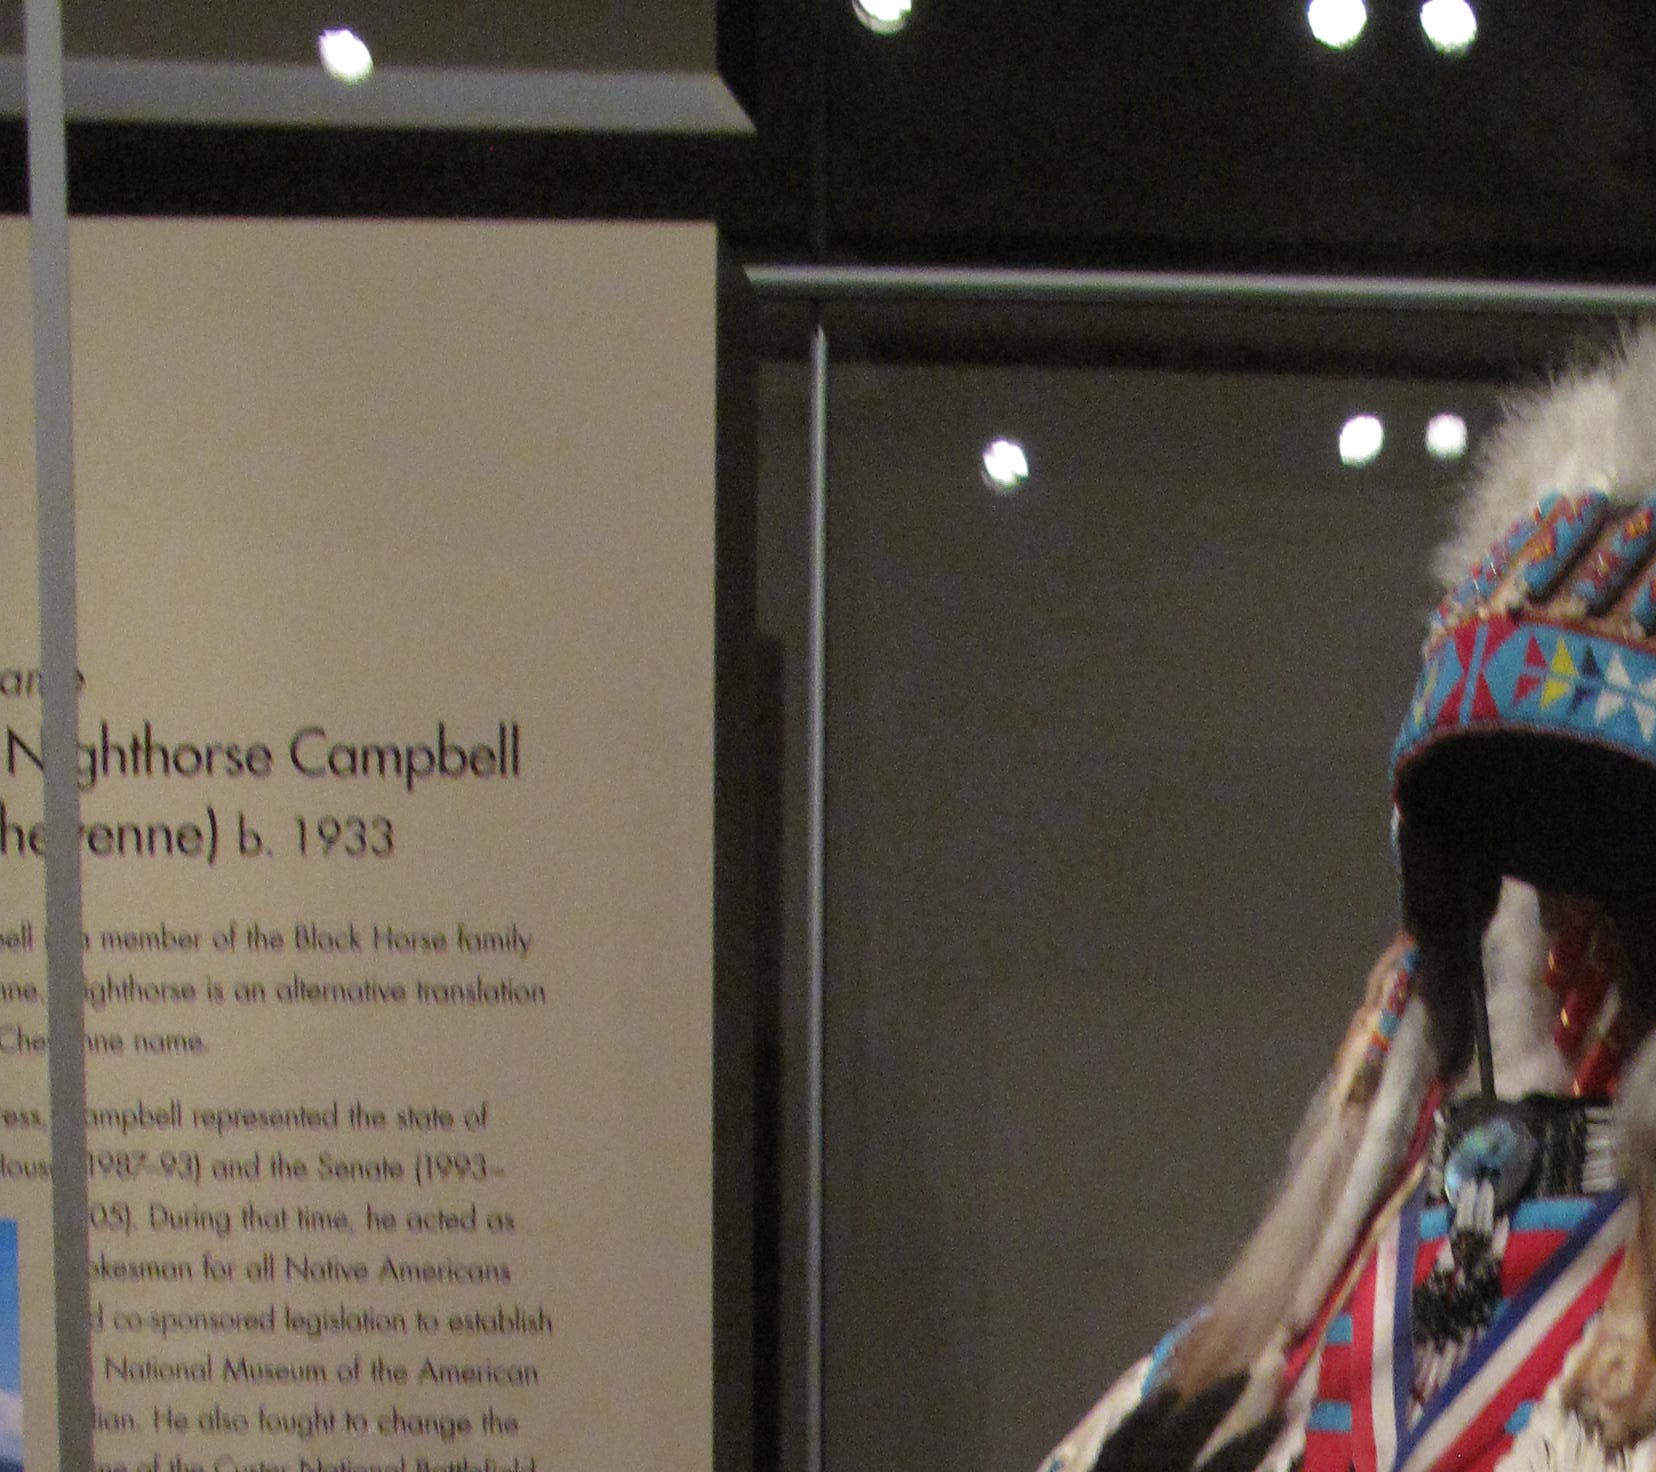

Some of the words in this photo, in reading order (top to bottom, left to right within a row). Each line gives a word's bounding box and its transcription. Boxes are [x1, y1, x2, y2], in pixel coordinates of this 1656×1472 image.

[7, 717, 273, 792] Nghthorse
[289, 719, 519, 795] Campbell
[238, 808, 273, 858] b.
[298, 812, 394, 858] 1933
[102, 922, 199, 952] member
[212, 919, 236, 953] of
[246, 922, 285, 952] the
[294, 920, 360, 951] Black
[372, 921, 447, 951] Horse
[457, 921, 533, 960] family
[206, 974, 225, 1003] is
[234, 982, 266, 1003] an
[276, 971, 406, 1003] alternative
[416, 970, 546, 1003] translation
[134, 1030, 206, 1056] name.
[85, 1097, 182, 1136] ampbell
[193, 1099, 337, 1137] represented
[349, 1100, 386, 1130] the
[397, 1104, 454, 1131] state
[463, 1100, 488, 1131] of
[211, 1152, 259, 1181] and
[270, 1151, 308, 1180] the
[318, 1151, 404, 1181] Senate
[150, 1201, 231, 1239] During
[241, 1201, 287, 1232] that
[366, 1200, 397, 1232] he
[405, 1201, 477, 1233] acted
[486, 1212, 515, 1234] as
[203, 1250, 233, 1281] for
[246, 1251, 275, 1283] all
[285, 1251, 368, 1284] Native
[379, 1255, 511, 1284] Americans
[113, 1302, 275, 1341] co-sponsored
[284, 1303, 407, 1343] legislation
[416, 1308, 439, 1335] to
[449, 1304, 552, 1335] establish
[104, 1352, 213, 1384] National
[223, 1353, 326, 1384] Museum
[336, 1354, 360, 1384] of
[370, 1353, 407, 1385] the
[417, 1356, 539, 1386] American
[152, 1403, 188, 1433] He
[199, 1400, 249, 1433] also
[258, 1402, 335, 1440] fought
[345, 1408, 368, 1437] to
[377, 1403, 472, 1445] change
[482, 1404, 519, 1436] the
